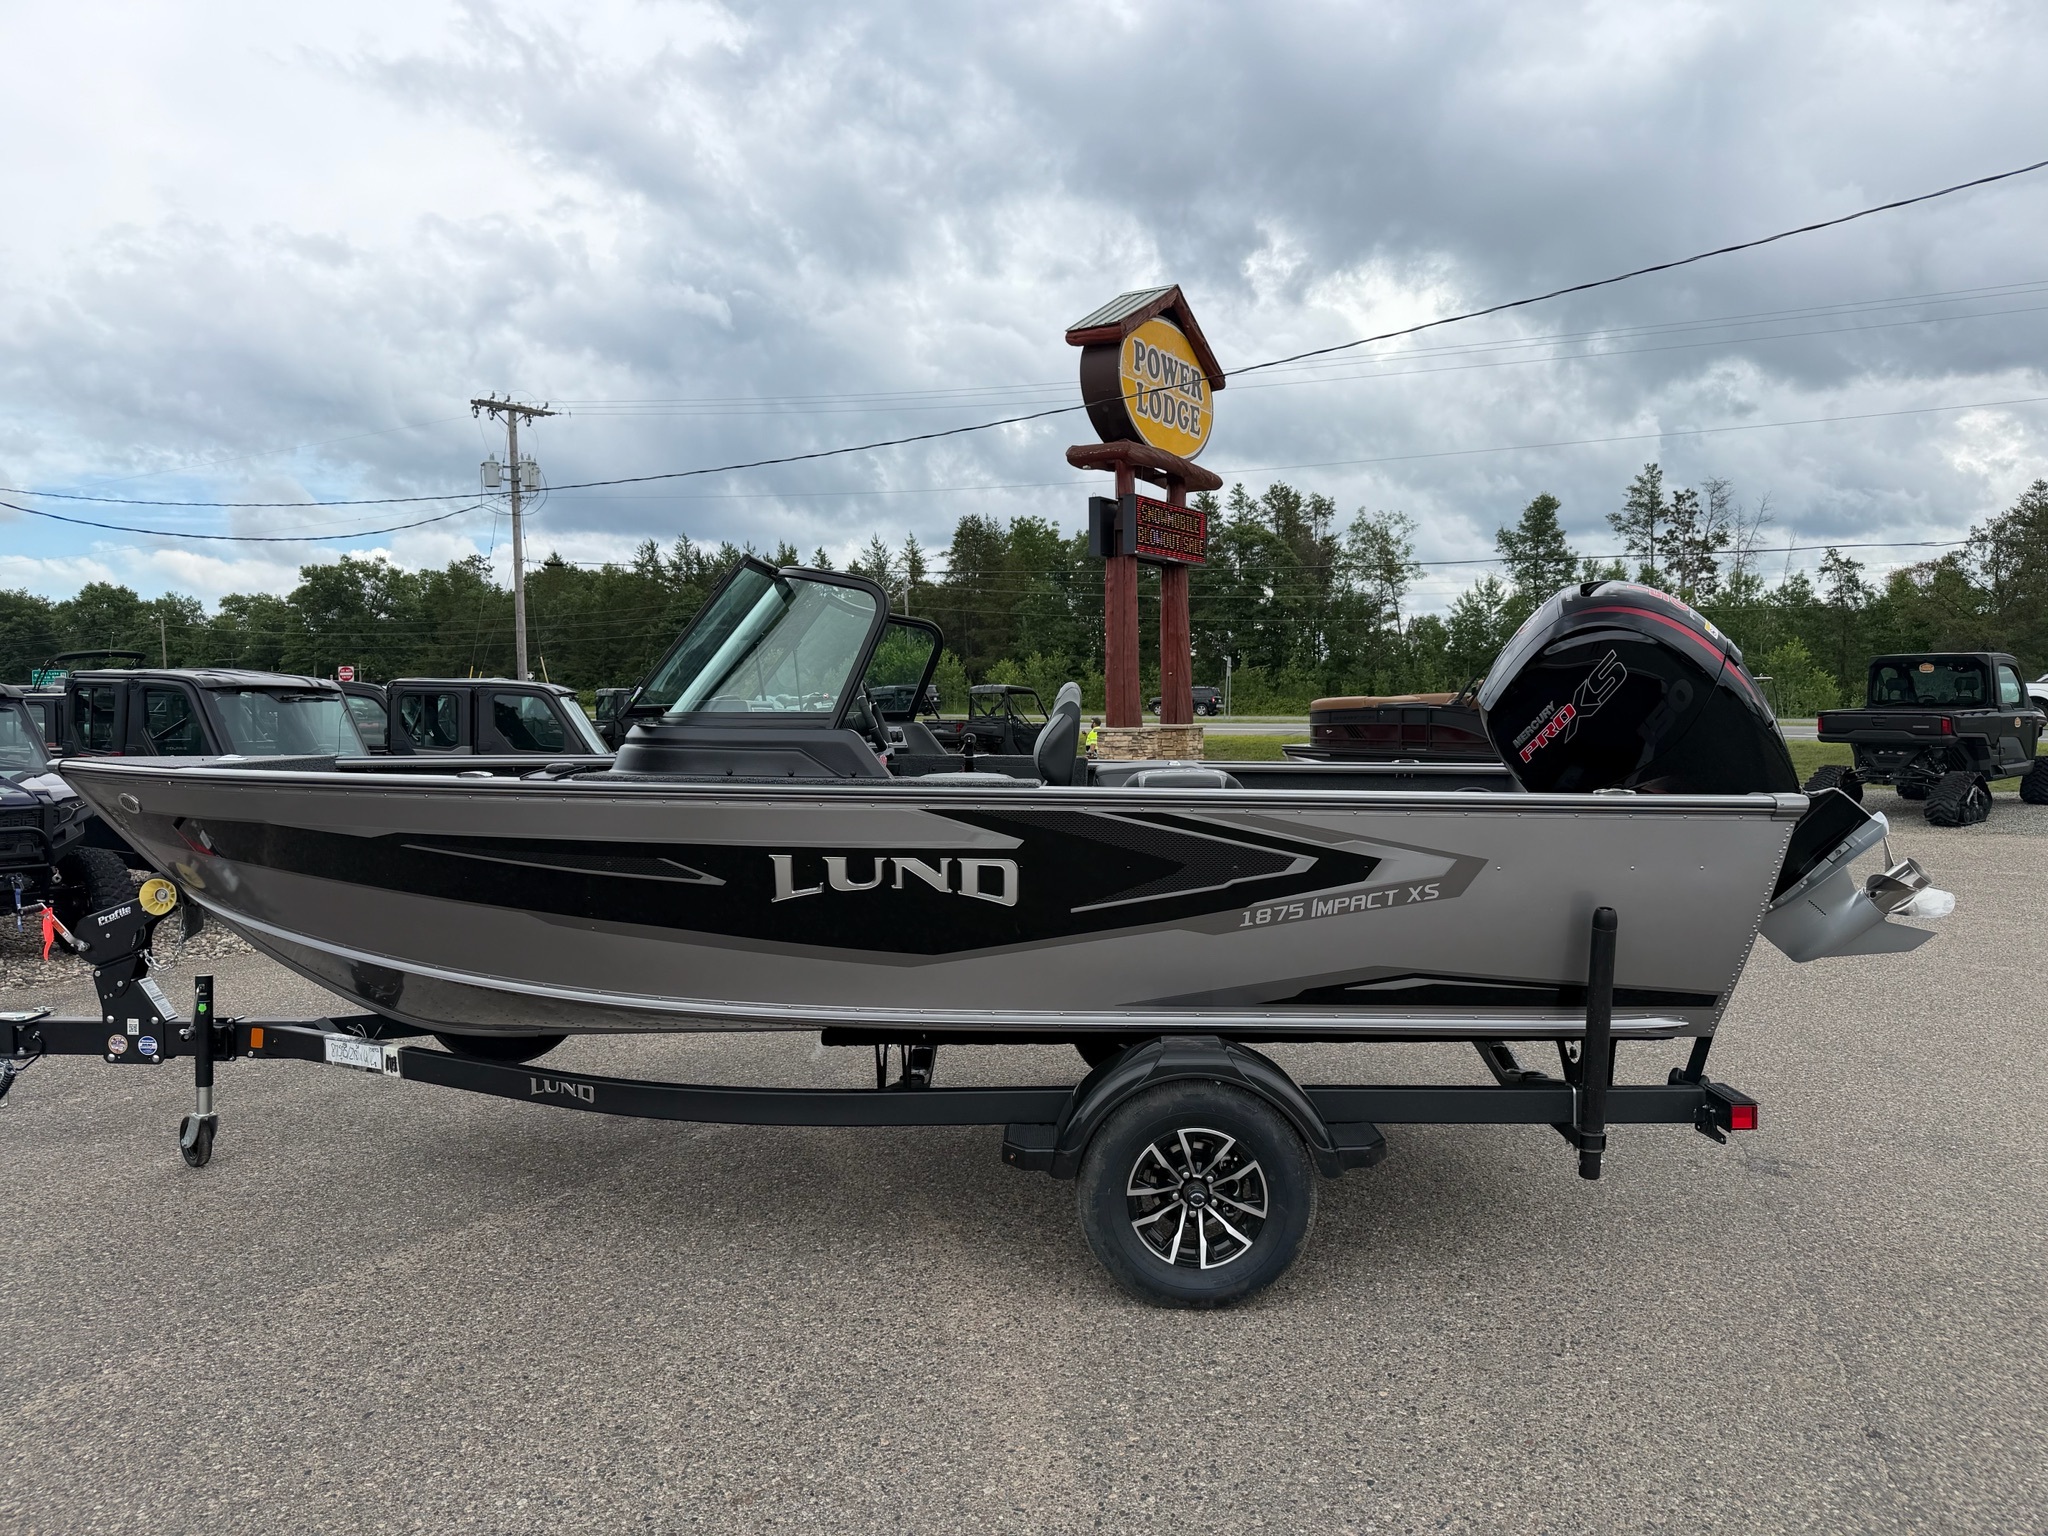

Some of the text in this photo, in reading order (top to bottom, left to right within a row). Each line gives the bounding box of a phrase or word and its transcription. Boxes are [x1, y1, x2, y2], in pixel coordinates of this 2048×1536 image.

[1133, 339, 1203, 402] POWER
[1136, 381, 1201, 437] LODGE
[1138, 526, 1204, 555] BLOWOUT SALE
[1141, 504, 1200, 533] SNOWMOBILE
[1512, 700, 1556, 748] MERCURY
[1519, 649, 1628, 763] PRO XS
[768, 854, 1019, 907] LUND
[98, 906, 131, 926] Profile
[1239, 882, 1440, 927] 1875 IMPACT XS
[530, 1077, 595, 1104] LUND
